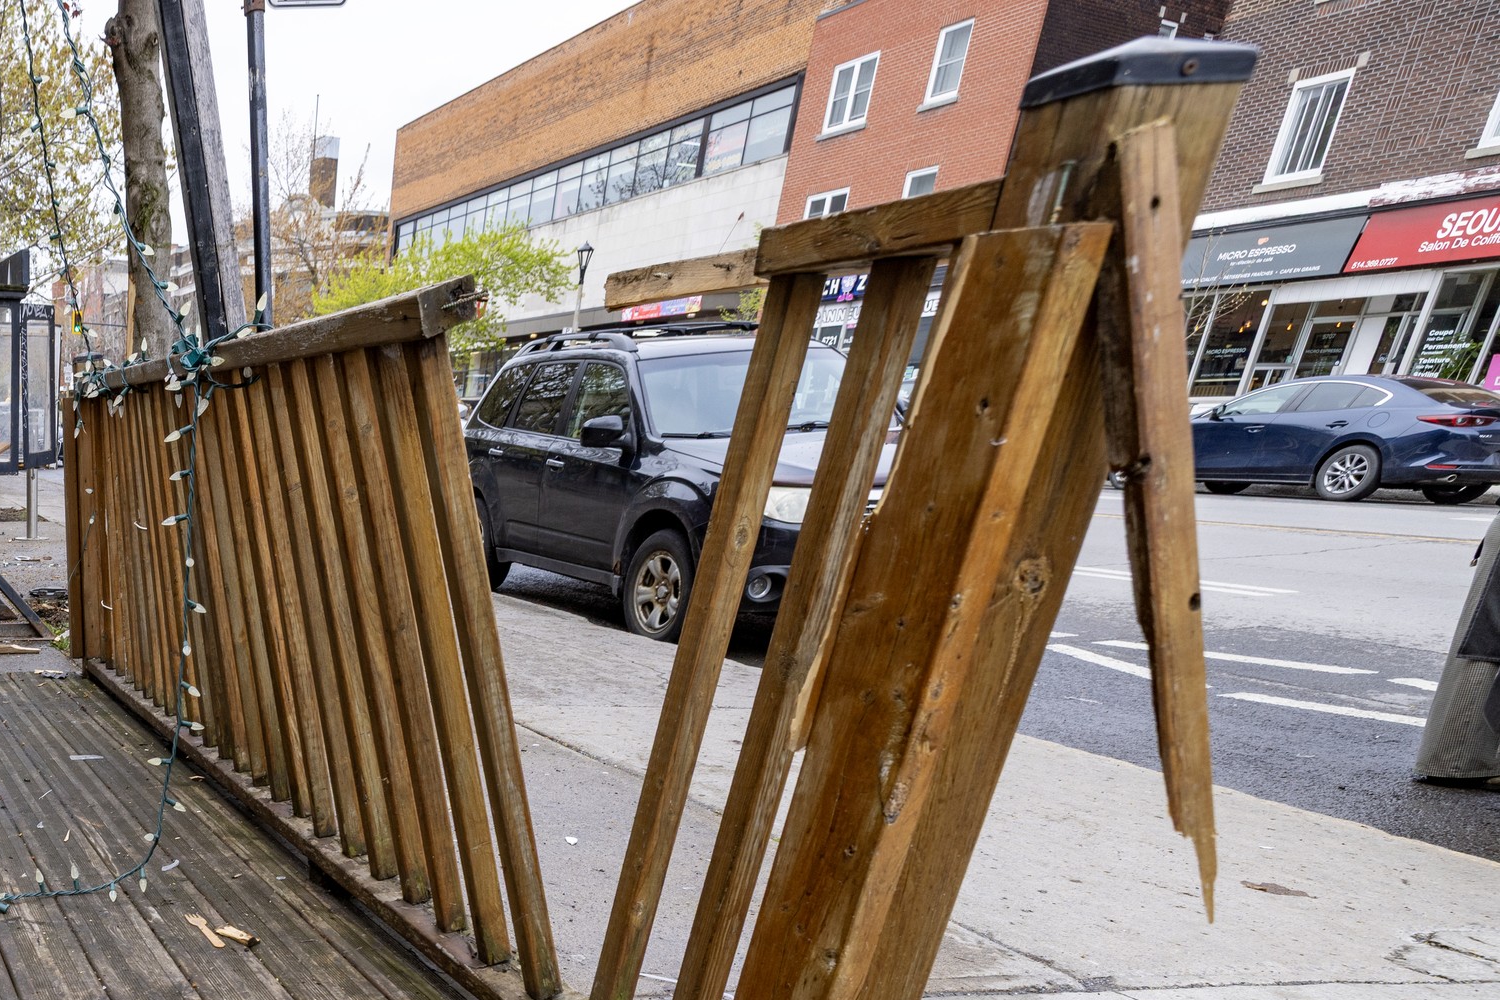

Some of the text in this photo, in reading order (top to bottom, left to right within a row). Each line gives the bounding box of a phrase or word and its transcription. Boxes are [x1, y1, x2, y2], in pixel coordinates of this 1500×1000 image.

[1436, 206, 1500, 239] SEOU
[1418, 241, 1450, 253] Salon
[1451, 237, 1470, 249] De
[1217, 243, 1297, 262] MICRO ESPRESSO
[1428, 329, 1455, 337] Coupe
[1422, 341, 1471, 351] Permanente
[1418, 356, 1451, 365] Teinture
